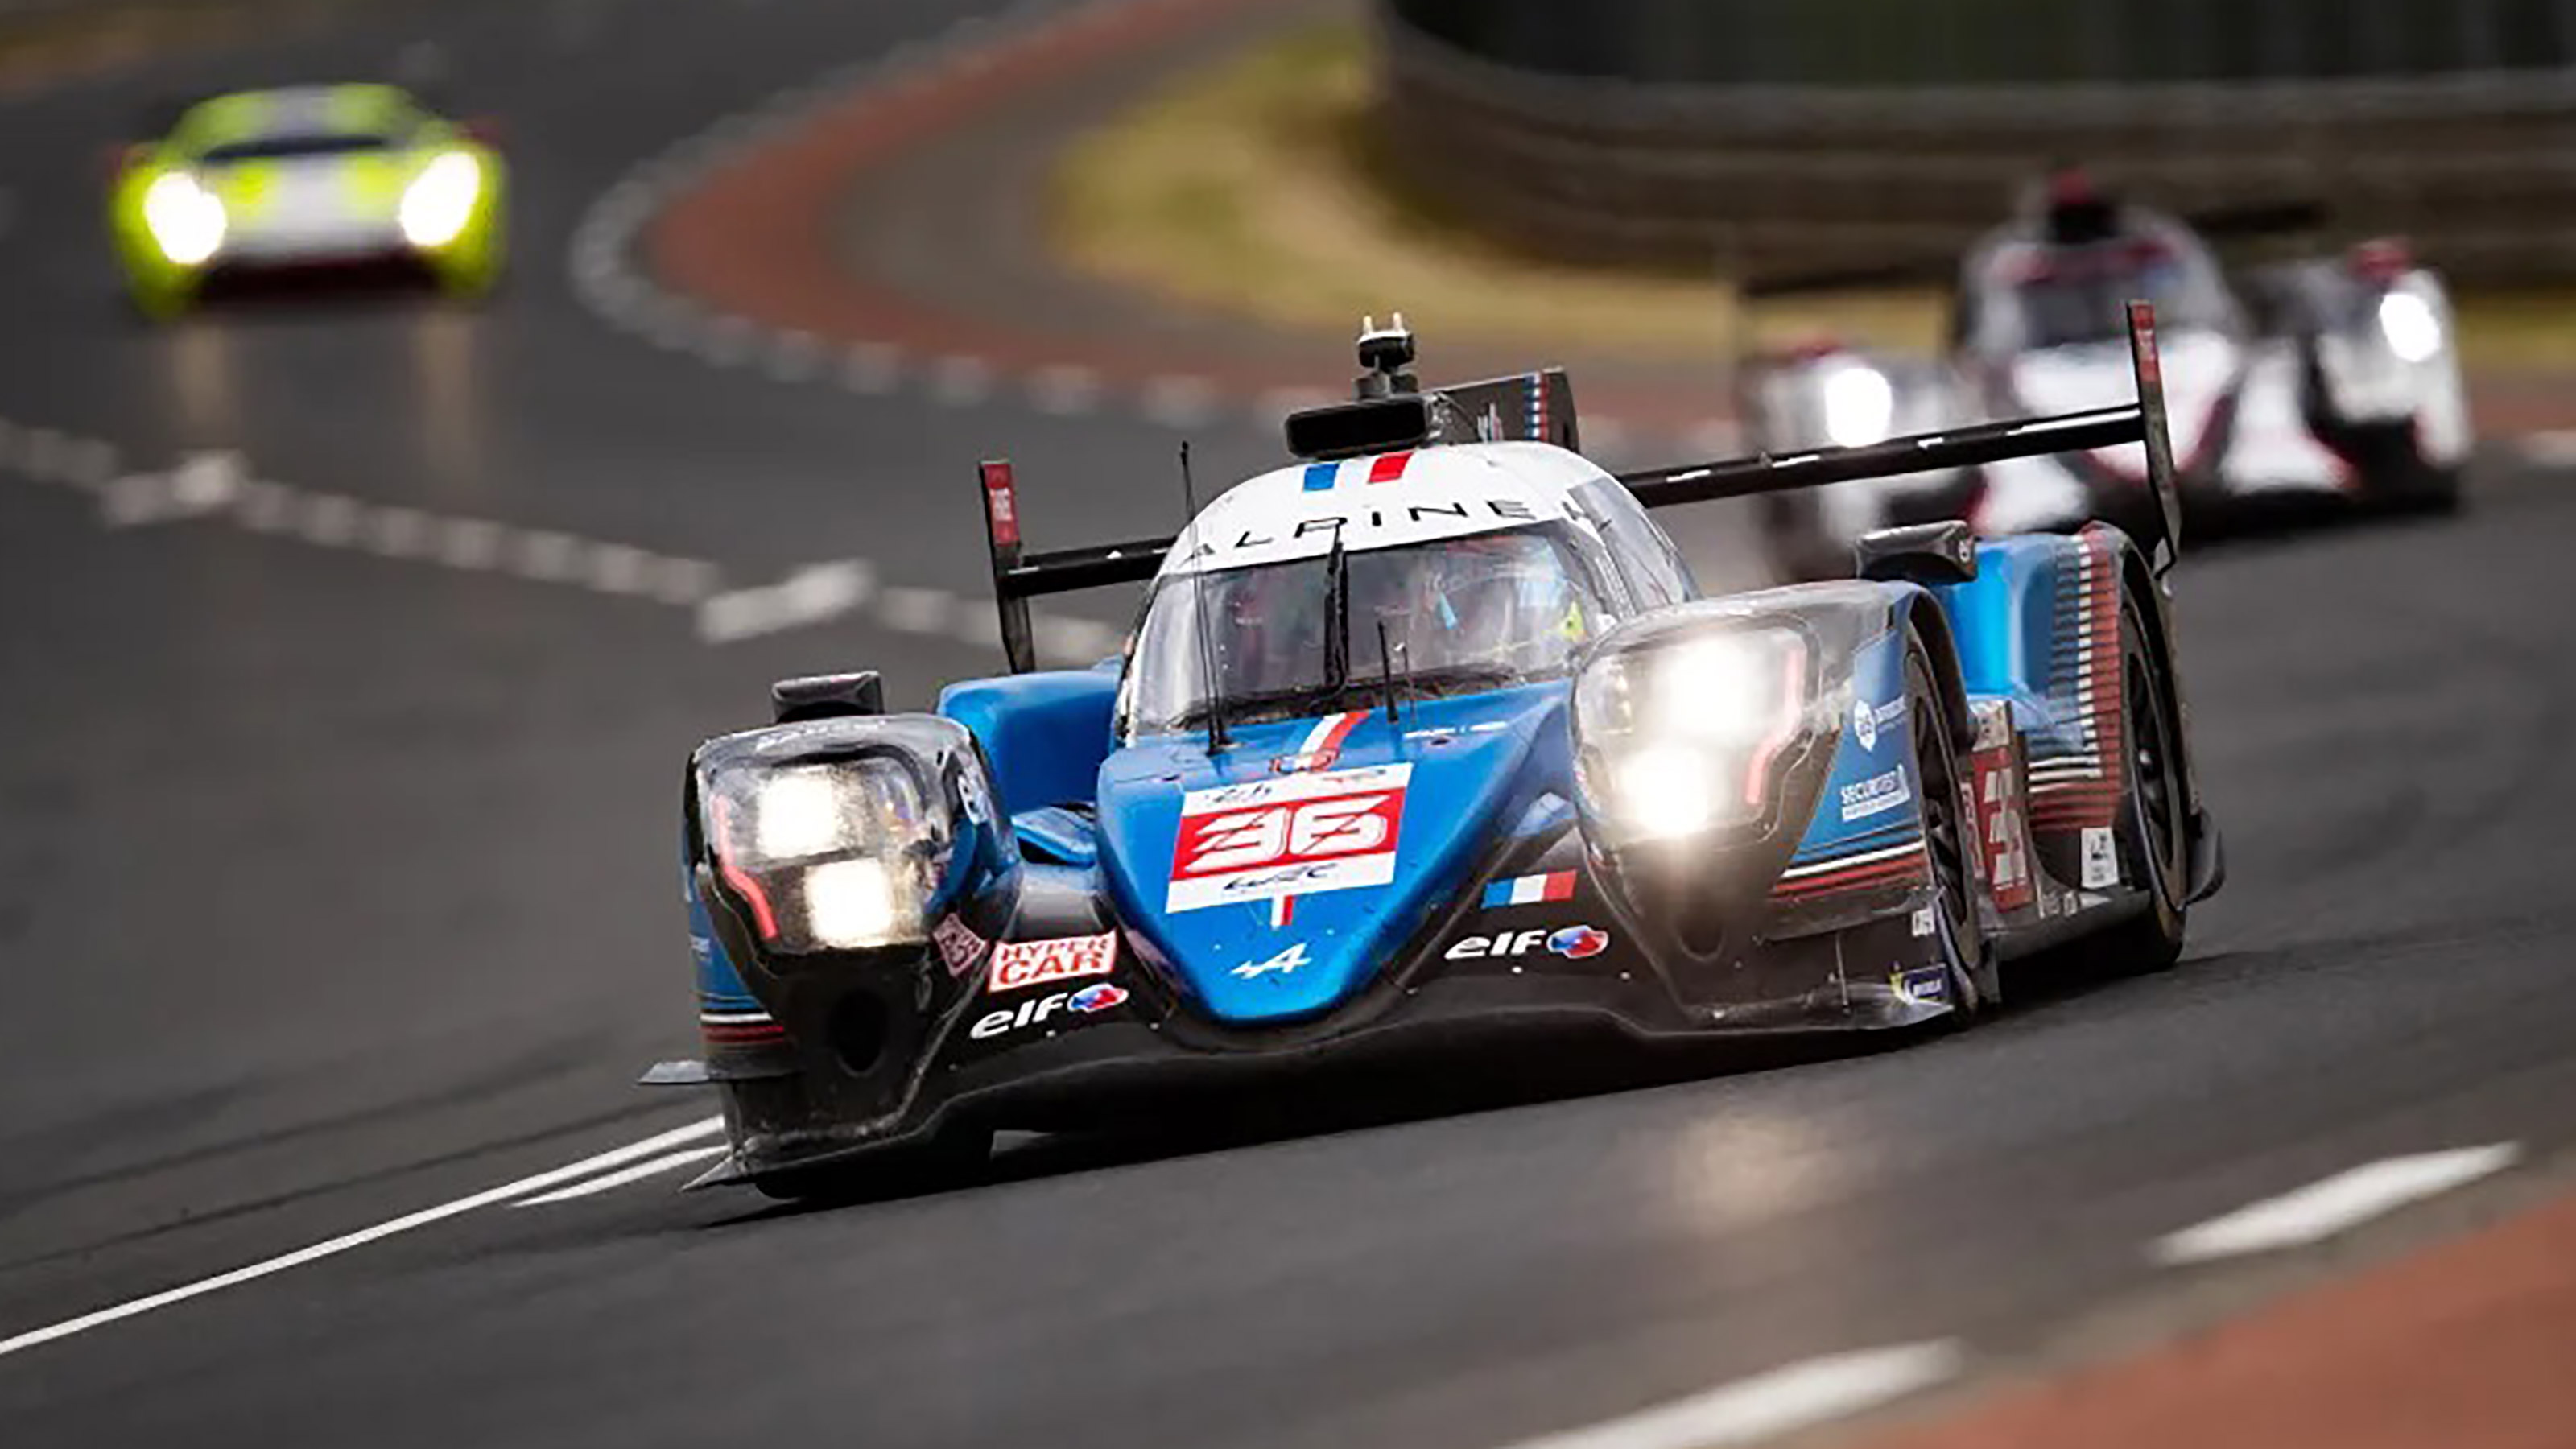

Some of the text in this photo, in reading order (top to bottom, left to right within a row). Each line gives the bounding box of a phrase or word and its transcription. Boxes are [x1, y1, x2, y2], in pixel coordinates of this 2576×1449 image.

[1183, 501, 1536, 563] ALPINE
[1183, 795, 1391, 873] 36
[1001, 939, 1108, 961] HYPER
[1444, 929, 1547, 960] elf
[998, 950, 1104, 985] CAR
[969, 993, 1068, 1040] elf
